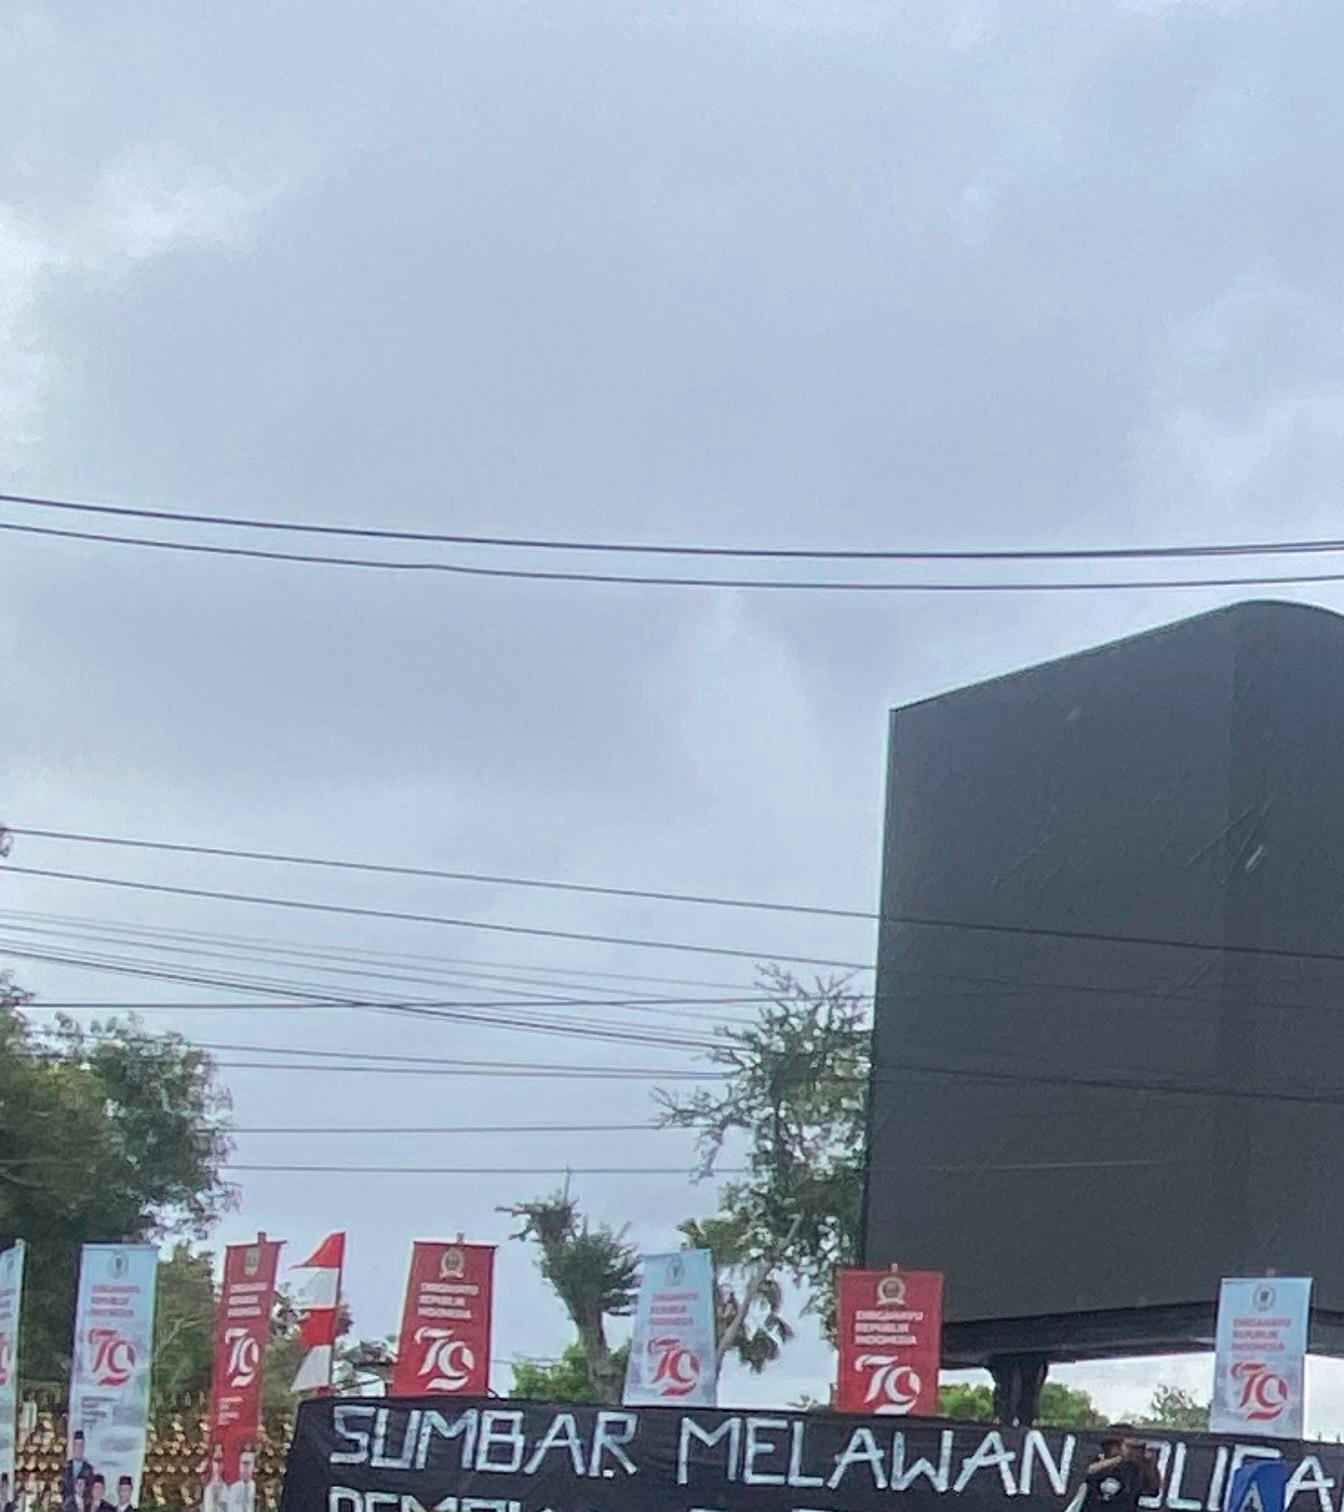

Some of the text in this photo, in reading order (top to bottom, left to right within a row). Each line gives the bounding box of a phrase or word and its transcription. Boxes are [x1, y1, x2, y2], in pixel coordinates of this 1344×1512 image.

[415, 1326, 475, 1391] 79
[854, 1354, 921, 1415] 79
[1230, 1362, 1287, 1420] 79
[329, 1405, 639, 1479] SUMBAR
[677, 1416, 1076, 1496] MELAWAN
